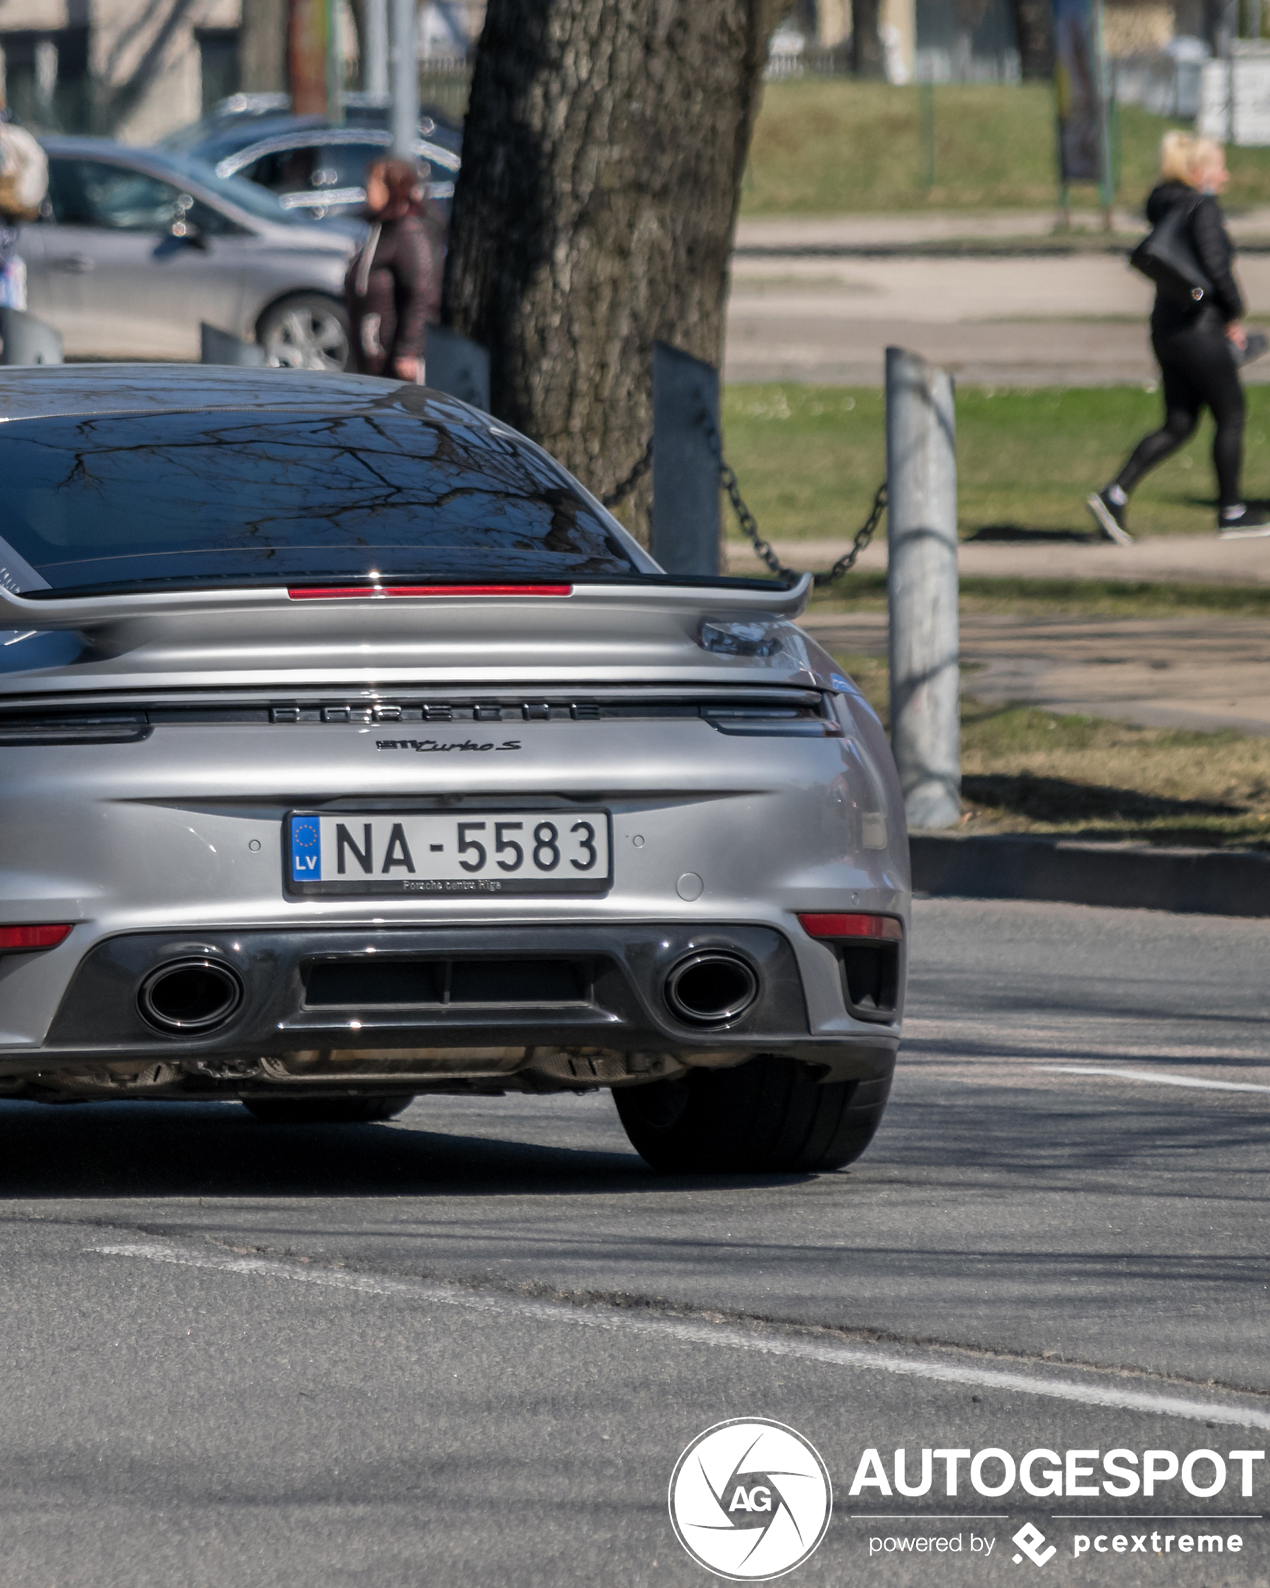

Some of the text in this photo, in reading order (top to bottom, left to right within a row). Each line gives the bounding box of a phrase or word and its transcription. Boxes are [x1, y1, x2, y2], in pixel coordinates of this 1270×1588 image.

[269, 704, 601, 723] PORSCHE
[495, 740, 522, 751] S
[335, 821, 599, 875] NA-5583
[295, 855, 318, 871] LV
[403, 880, 443, 891] Porsche
